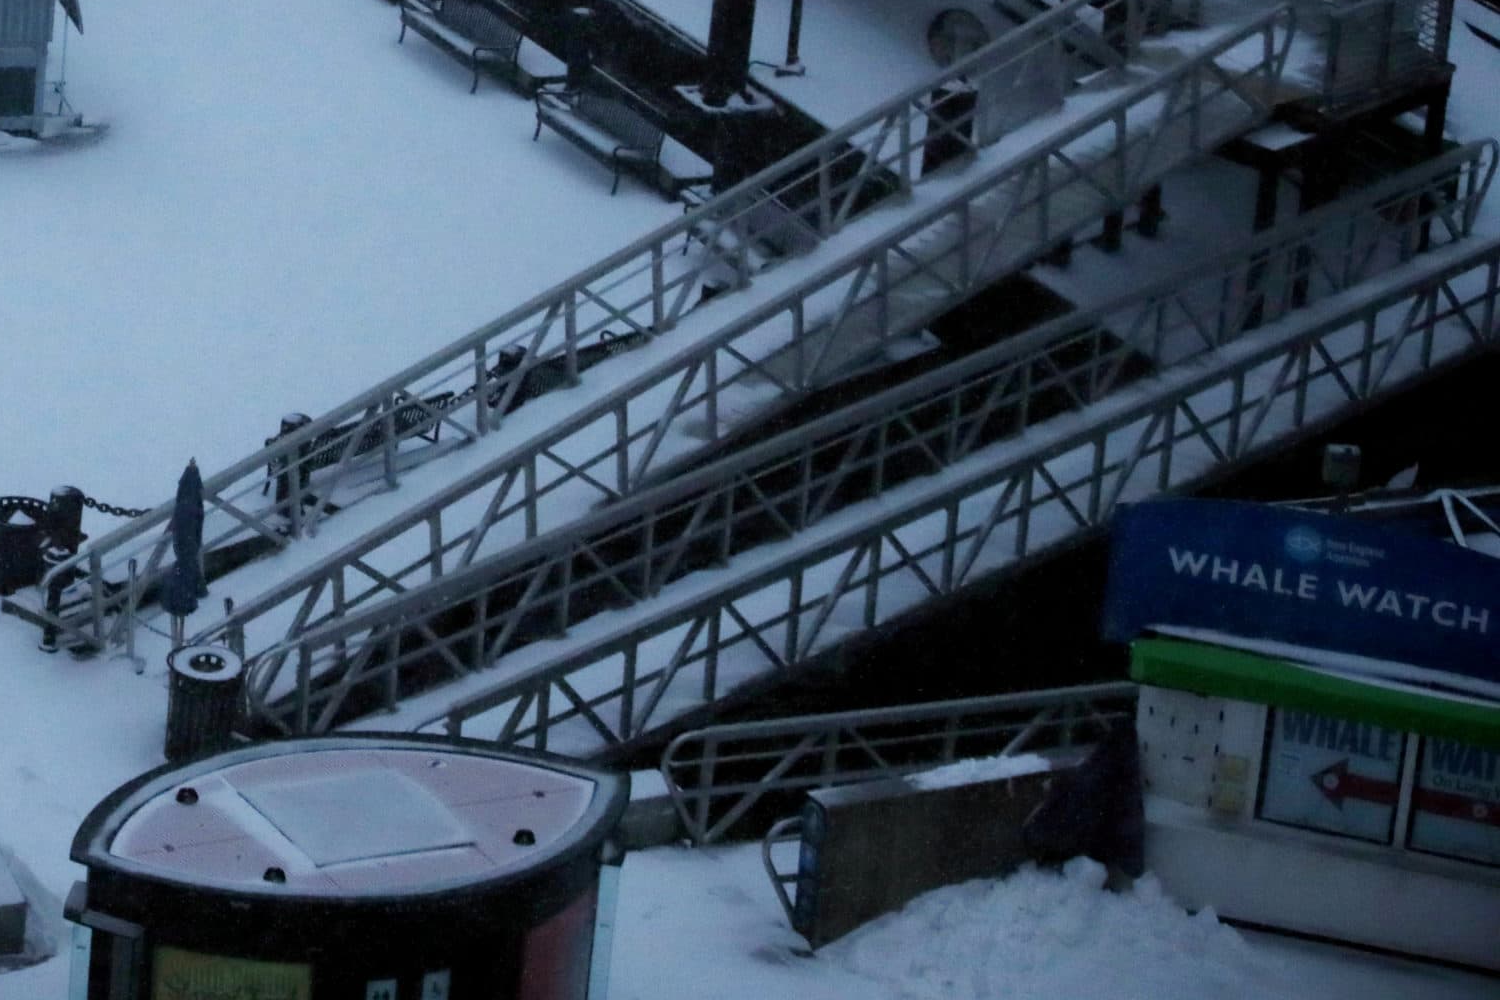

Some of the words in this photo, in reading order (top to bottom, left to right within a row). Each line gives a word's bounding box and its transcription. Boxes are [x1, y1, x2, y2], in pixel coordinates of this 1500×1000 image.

[1168, 546, 1319, 600] WHALE
[1337, 579, 1490, 634] WATCH
[1283, 710, 1398, 761] WHALE
